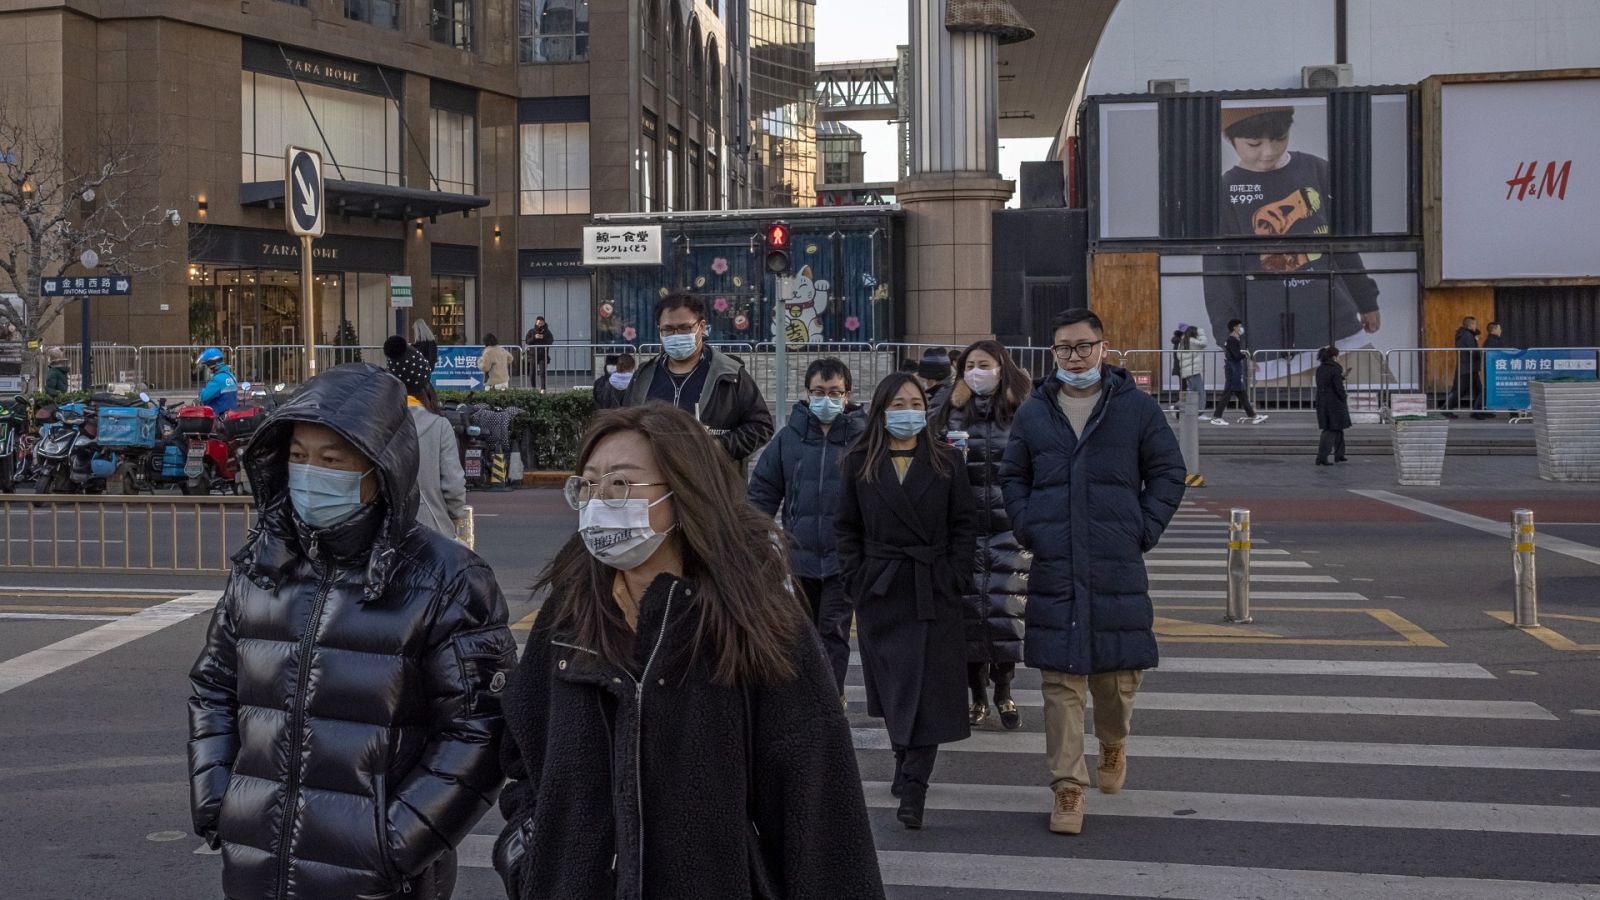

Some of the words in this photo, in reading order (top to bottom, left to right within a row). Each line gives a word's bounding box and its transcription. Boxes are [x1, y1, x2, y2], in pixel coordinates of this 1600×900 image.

[285, 58, 320, 75] ZARA
[325, 66, 359, 82] HOME
[1505, 160, 1572, 201] H&M
[1230, 184, 1261, 193] 印花卫衣
[262, 243, 298, 257] ZARA
[312, 248, 339, 259] OME
[62, 278, 111, 288] 金桐西路
[1495, 359, 1553, 370] 疫情防控
